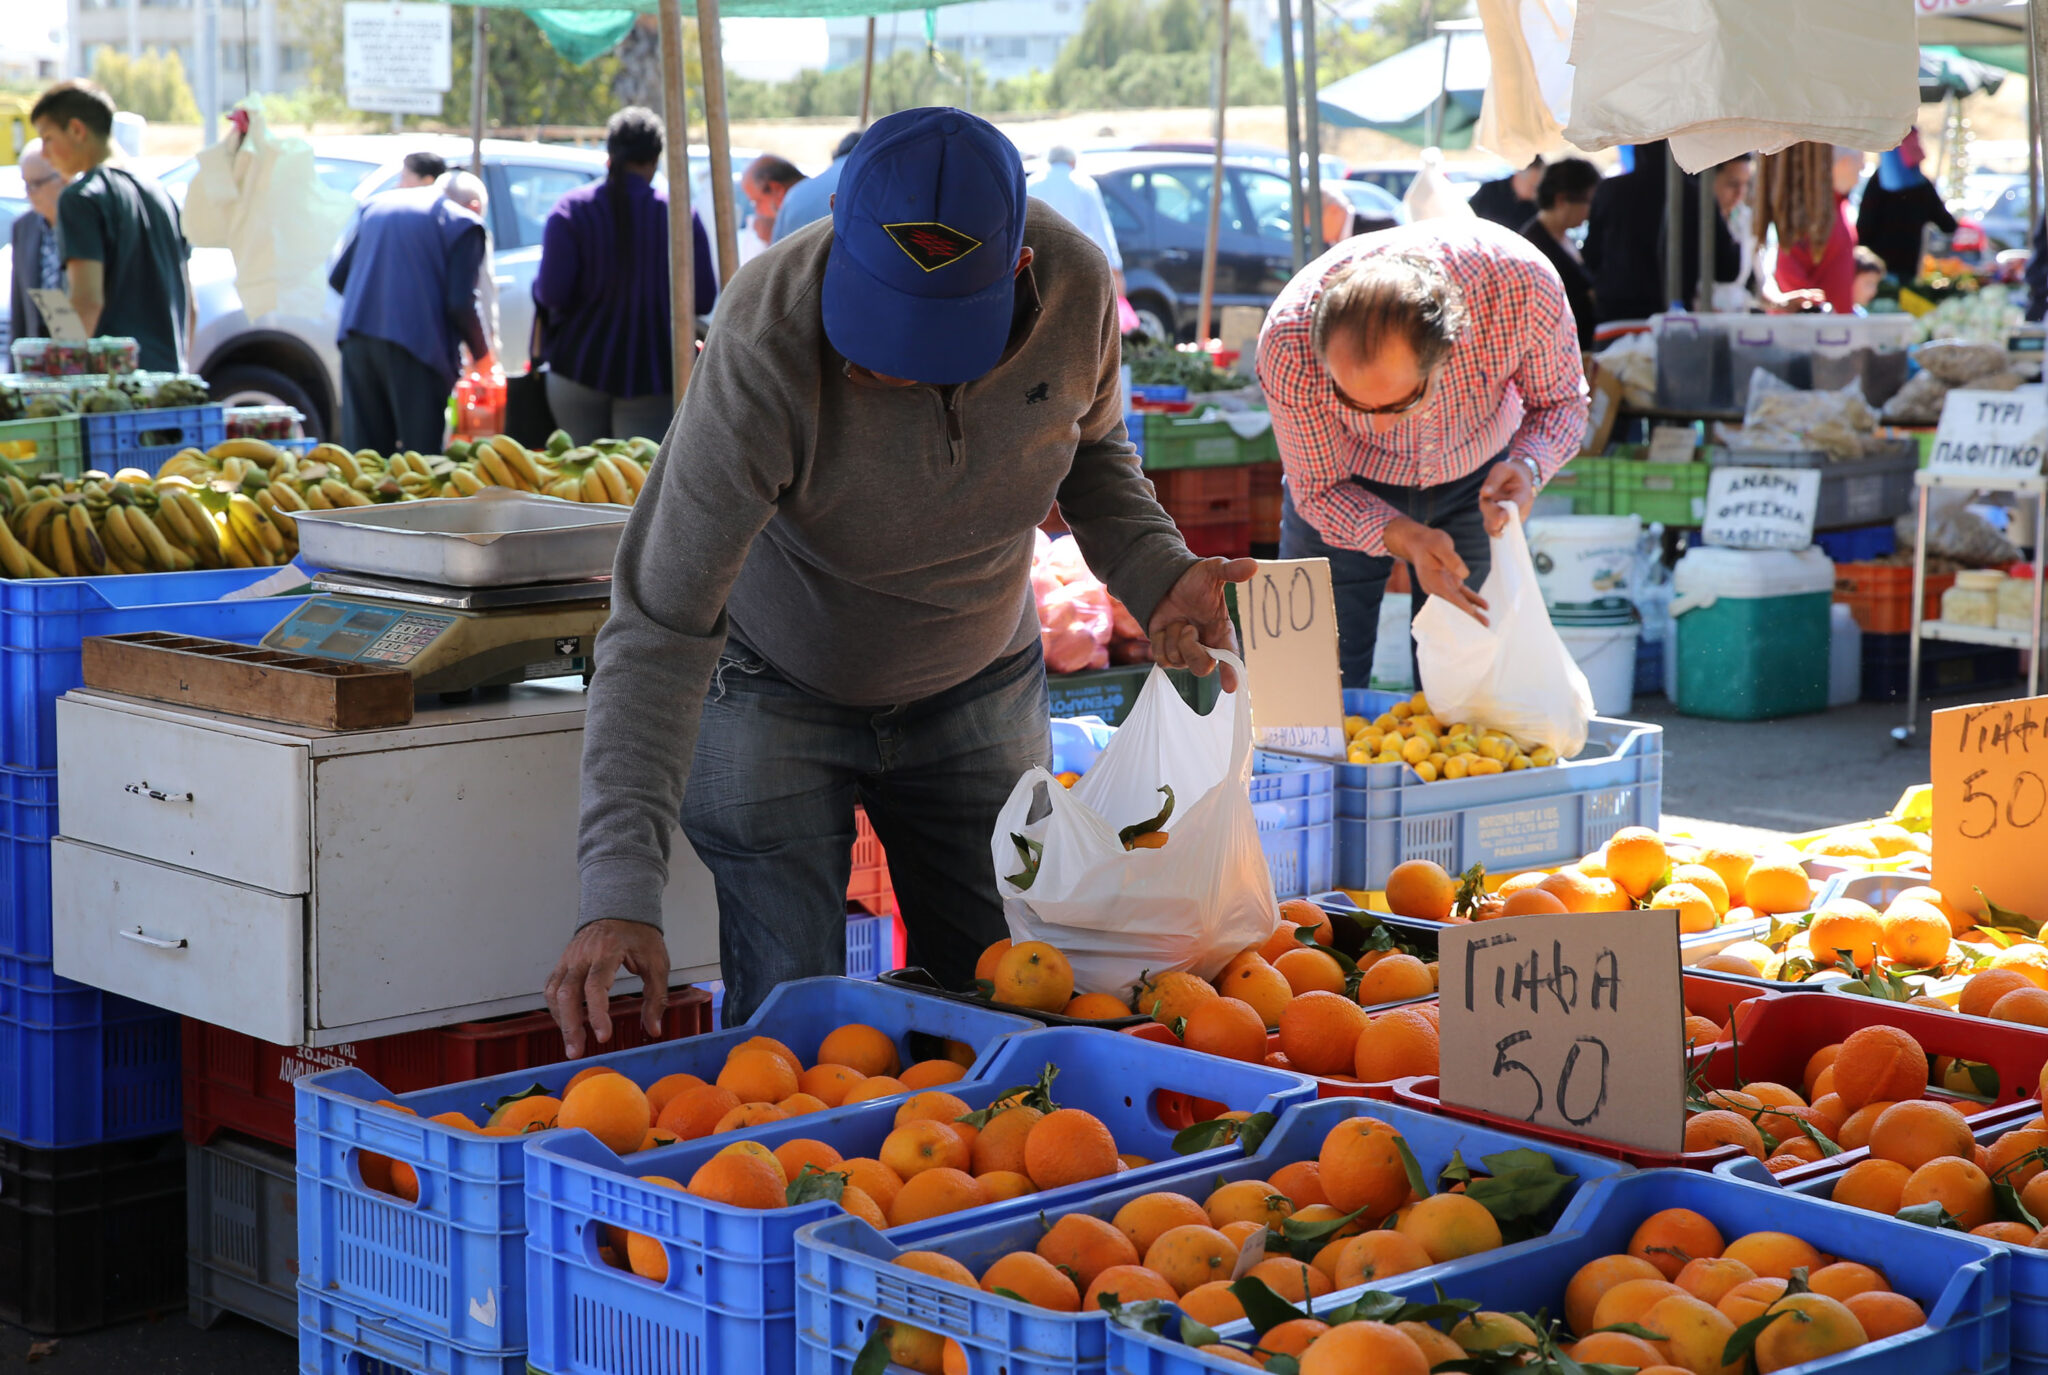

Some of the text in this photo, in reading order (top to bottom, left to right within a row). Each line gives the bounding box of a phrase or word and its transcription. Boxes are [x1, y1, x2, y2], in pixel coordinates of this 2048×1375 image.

[1977, 402, 2023, 423] ΤΥΡΙ
[1936, 442, 2039, 467] ΠΑΦΙΤΙΚΟ
[1249, 567, 1314, 650] 100
[1959, 768, 2047, 839] 50
[1493, 1029, 1609, 1126] 50
